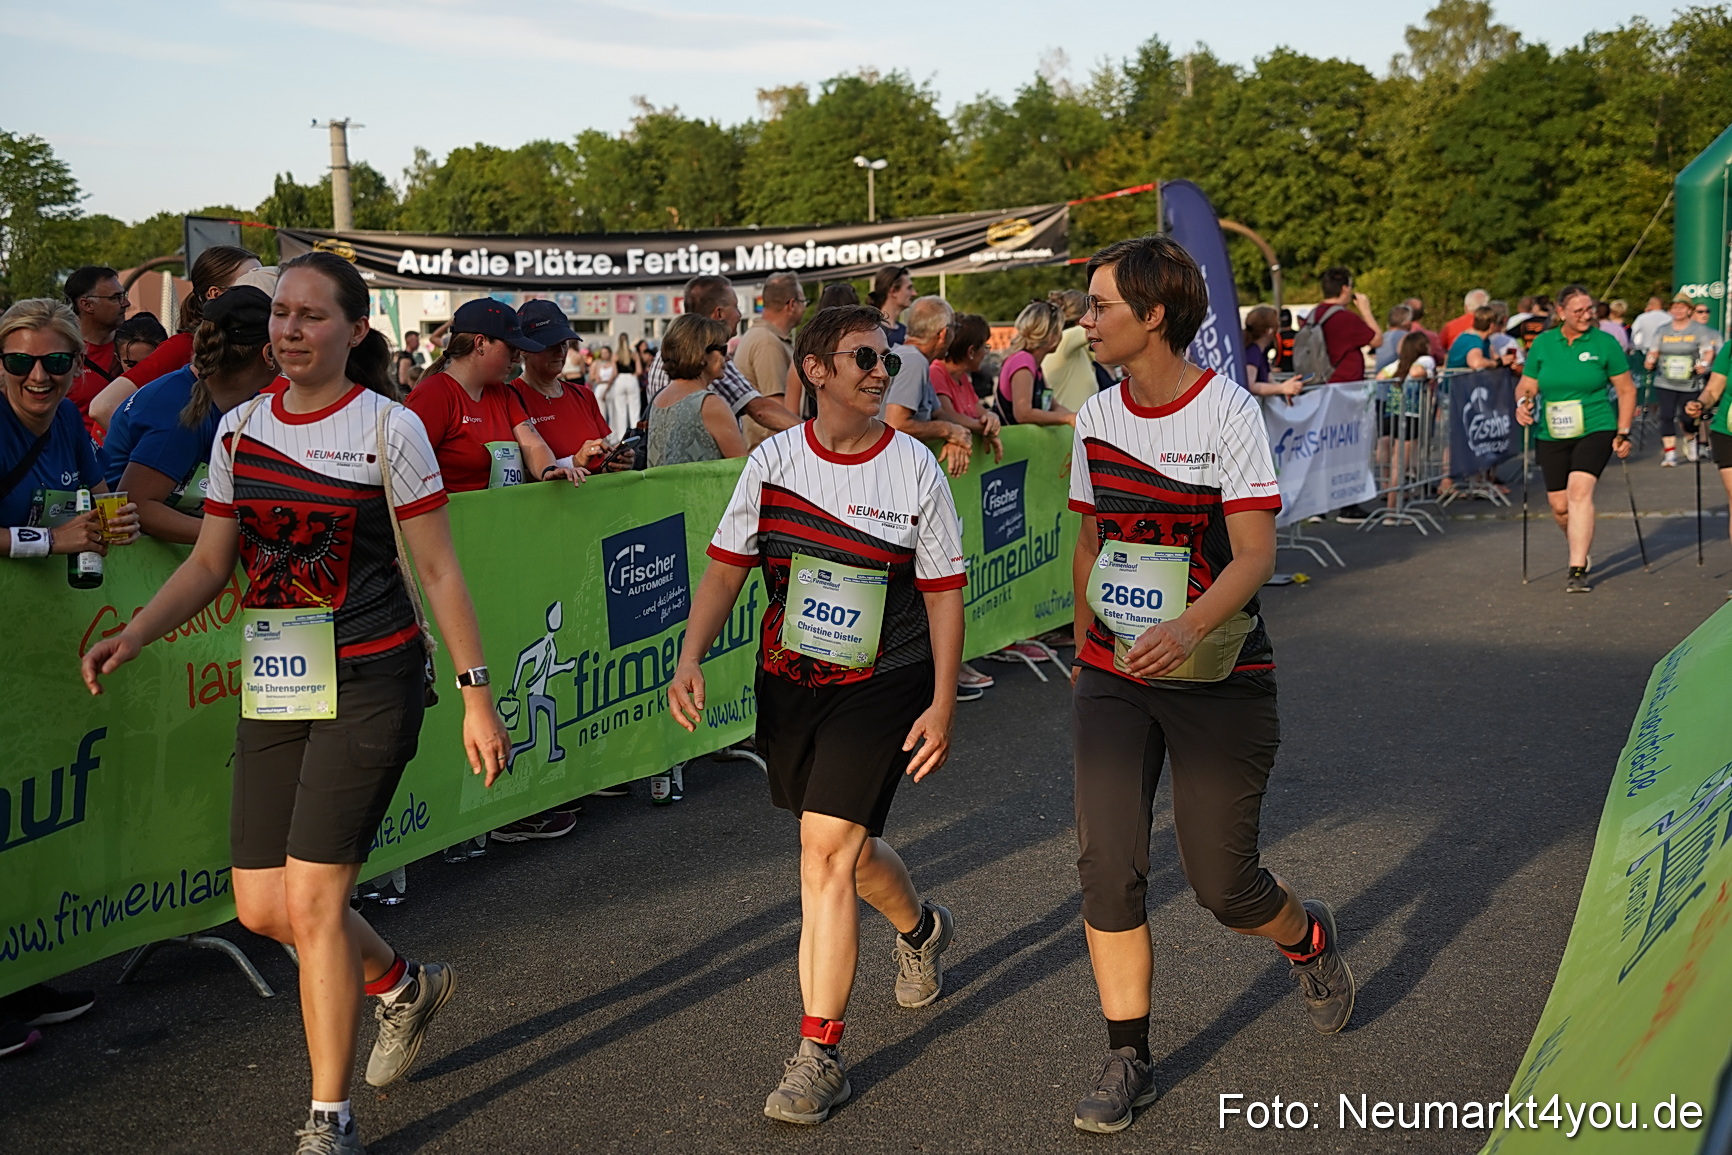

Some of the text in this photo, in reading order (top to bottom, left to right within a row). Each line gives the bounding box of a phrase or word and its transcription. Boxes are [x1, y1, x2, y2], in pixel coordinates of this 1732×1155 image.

[397, 248, 453, 275] Auf
[458, 247, 509, 276] die
[514, 248, 621, 276] Plätze.
[627, 244, 729, 277] Fertig.
[735, 236, 944, 271] Miteinander.
[1469, 410, 1511, 440] Fische
[306, 449, 364, 462] NEUMARKT
[1160, 452, 1209, 464] NEUMARKT
[503, 468, 522, 483] 790
[989, 488, 1019, 510] Fischer
[847, 504, 909, 524] NEUMARKT
[970, 512, 1061, 602] firmenlauf
[620, 553, 676, 587] Fischer
[628, 572, 674, 597] AUTOMOBILE
[972, 586, 1012, 622] neumarkt
[1101, 583, 1163, 609] 2660
[802, 598, 861, 628] 2607
[1104, 608, 1162, 624] Ester Thanner
[797, 621, 832, 638] Christine
[834, 630, 862, 643] Distler
[253, 655, 306, 677] 2610
[247, 682, 326, 694] Tanja Ehrensperger
